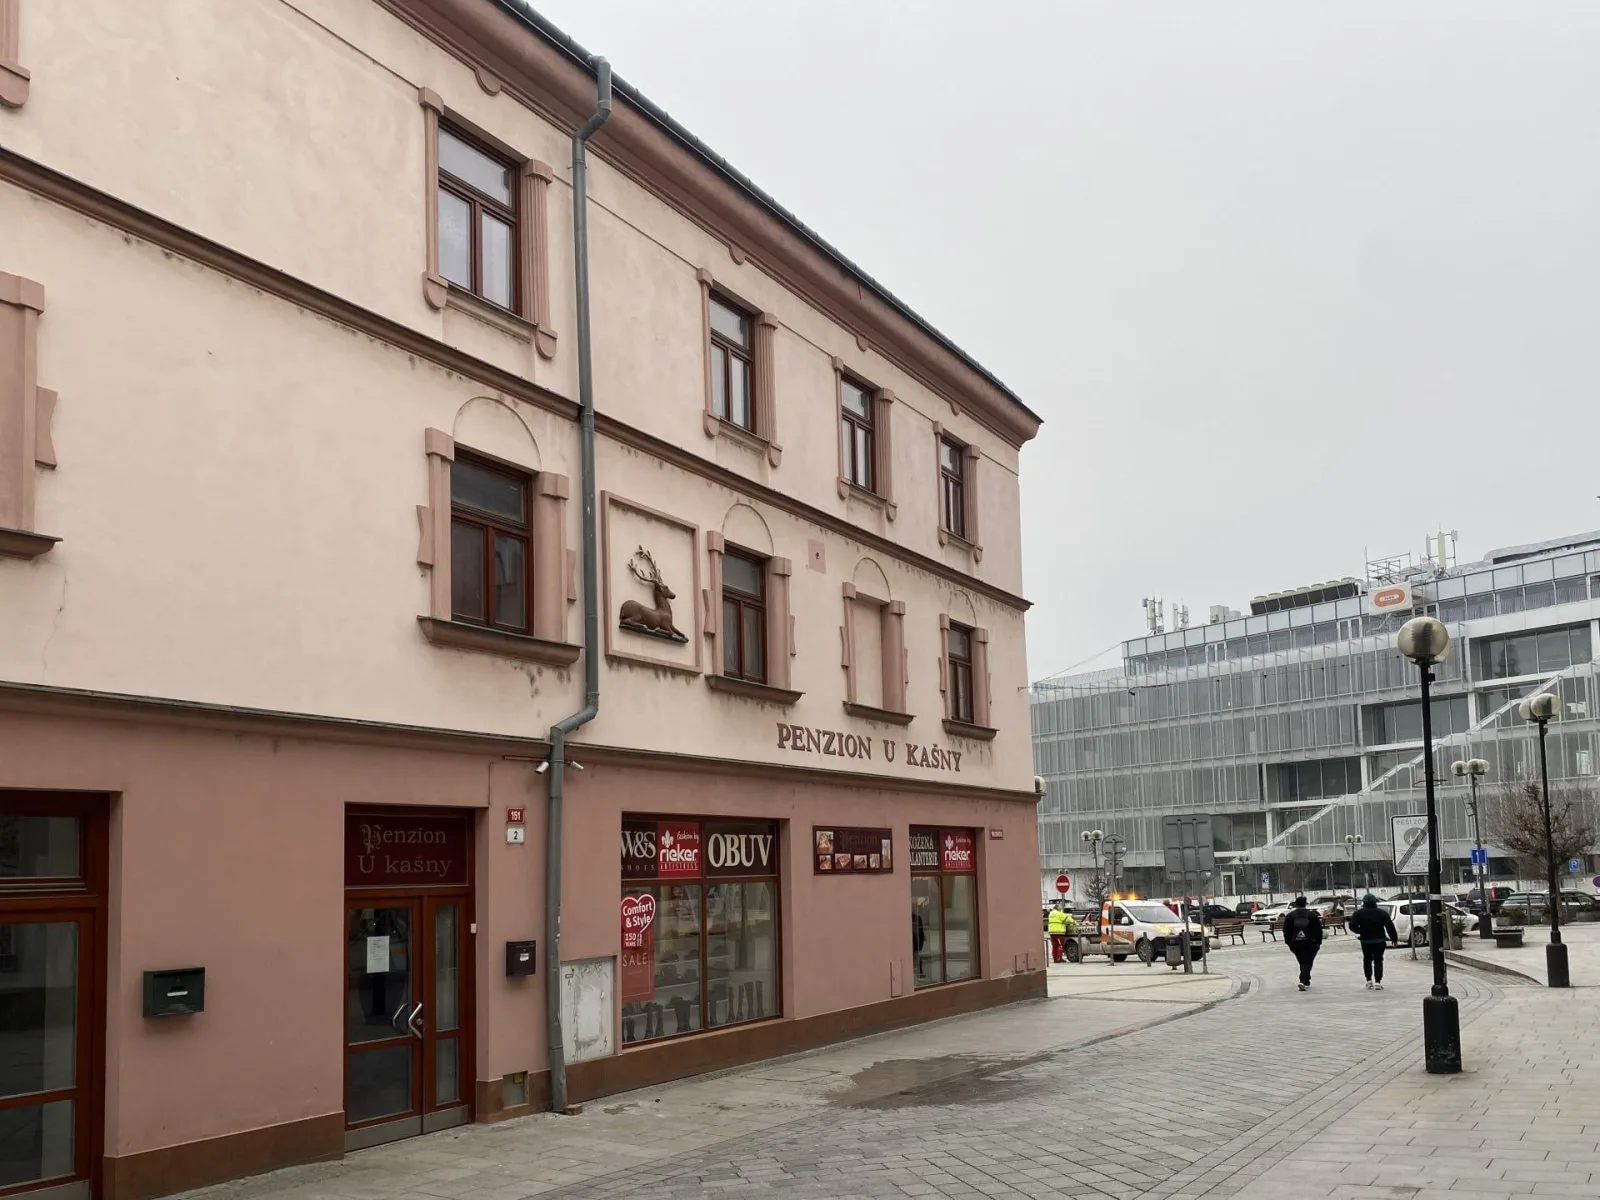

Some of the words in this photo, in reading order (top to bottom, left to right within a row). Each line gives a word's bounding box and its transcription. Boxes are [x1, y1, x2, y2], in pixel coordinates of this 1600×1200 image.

[776, 722, 872, 760] PENZION
[883, 739, 896, 763] U
[906, 743, 962, 772] KAŠNY
[511, 811, 521, 820] 151
[360, 824, 447, 854] Penzion
[513, 830, 518, 840] 2
[621, 830, 656, 859] W&S
[660, 843, 698, 862] rieker
[707, 833, 773, 868] OBUV
[944, 846, 971, 861] rieker
[358, 855, 375, 873] U
[385, 855, 452, 877] kašny
[622, 901, 652, 917] Comfort
[625, 918, 632, 928] &
[633, 914, 651, 929] Style
[625, 932, 637, 941] 150
[622, 952, 648, 967] SALE
